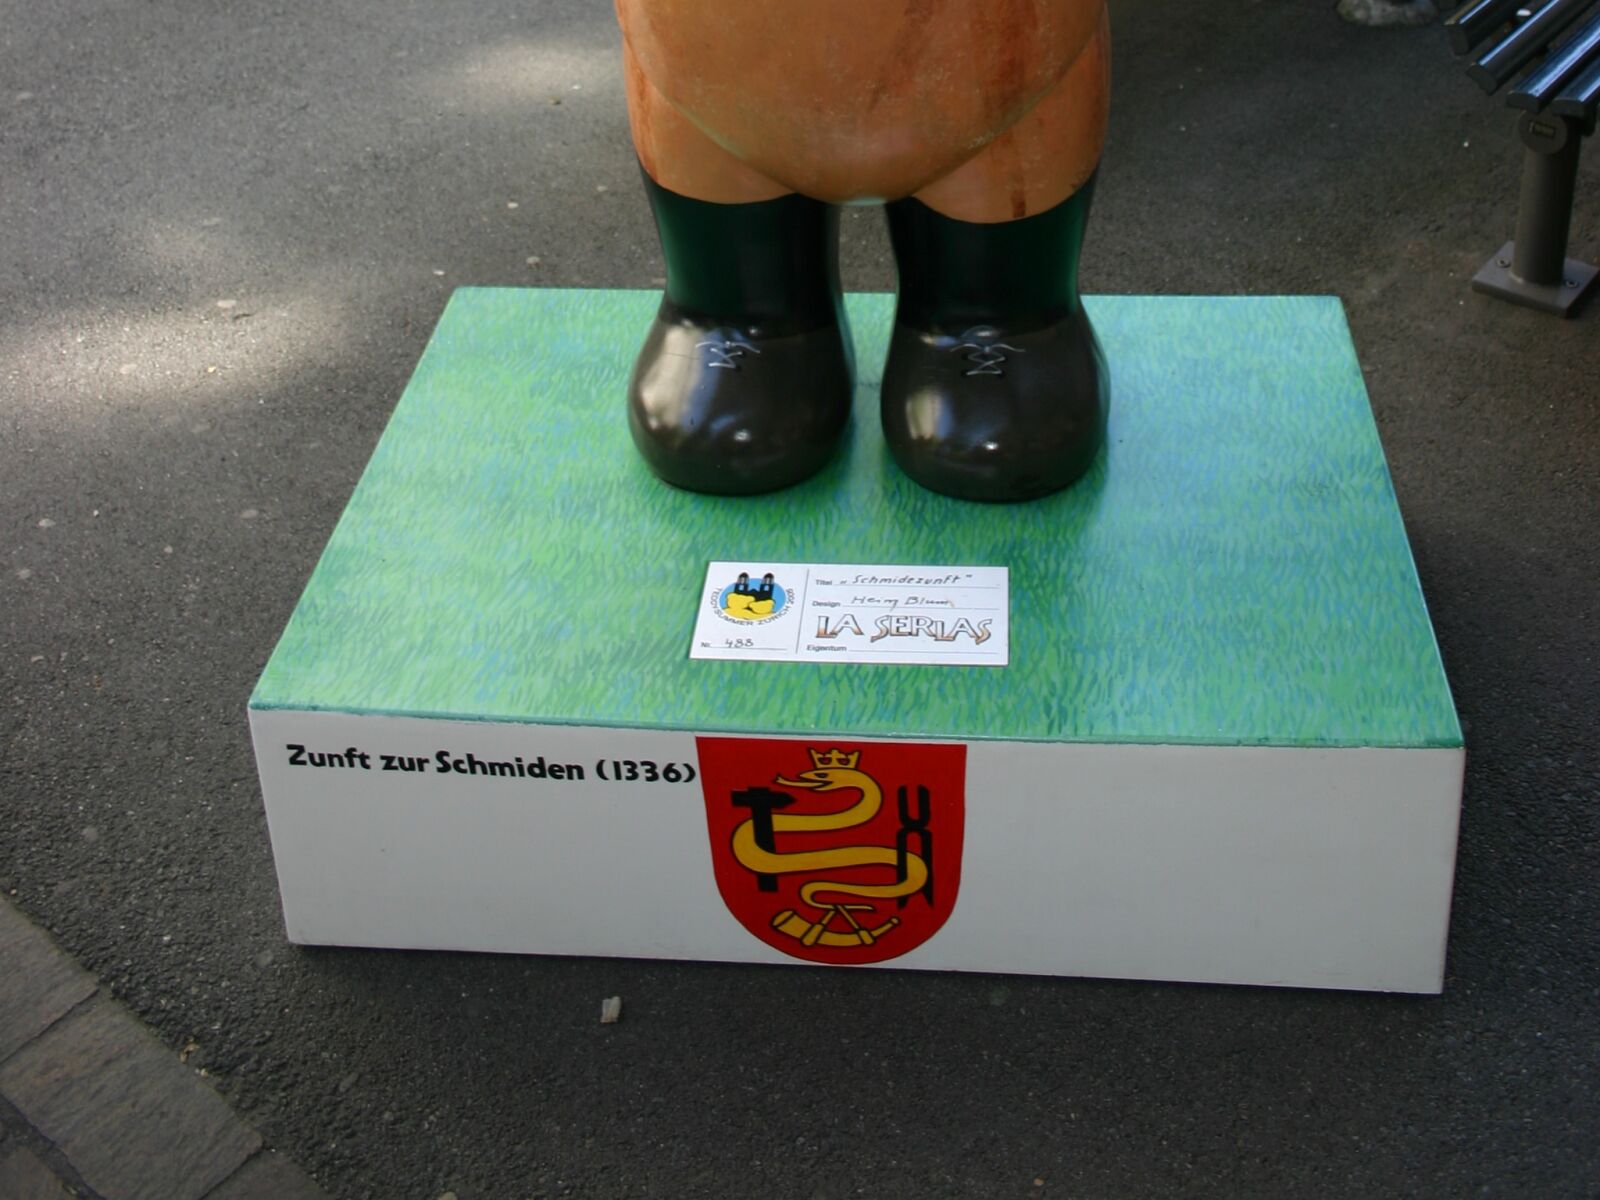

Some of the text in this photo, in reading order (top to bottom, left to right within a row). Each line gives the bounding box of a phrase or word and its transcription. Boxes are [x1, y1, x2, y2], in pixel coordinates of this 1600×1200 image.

[815, 578, 833, 586] Titel
[812, 600, 841, 608] Design
[815, 613, 865, 638] LA
[724, 638, 754, 649] 488
[807, 644, 847, 652] Eigentum
[286, 744, 697, 784] Zunft zur Schmiden (1336)
